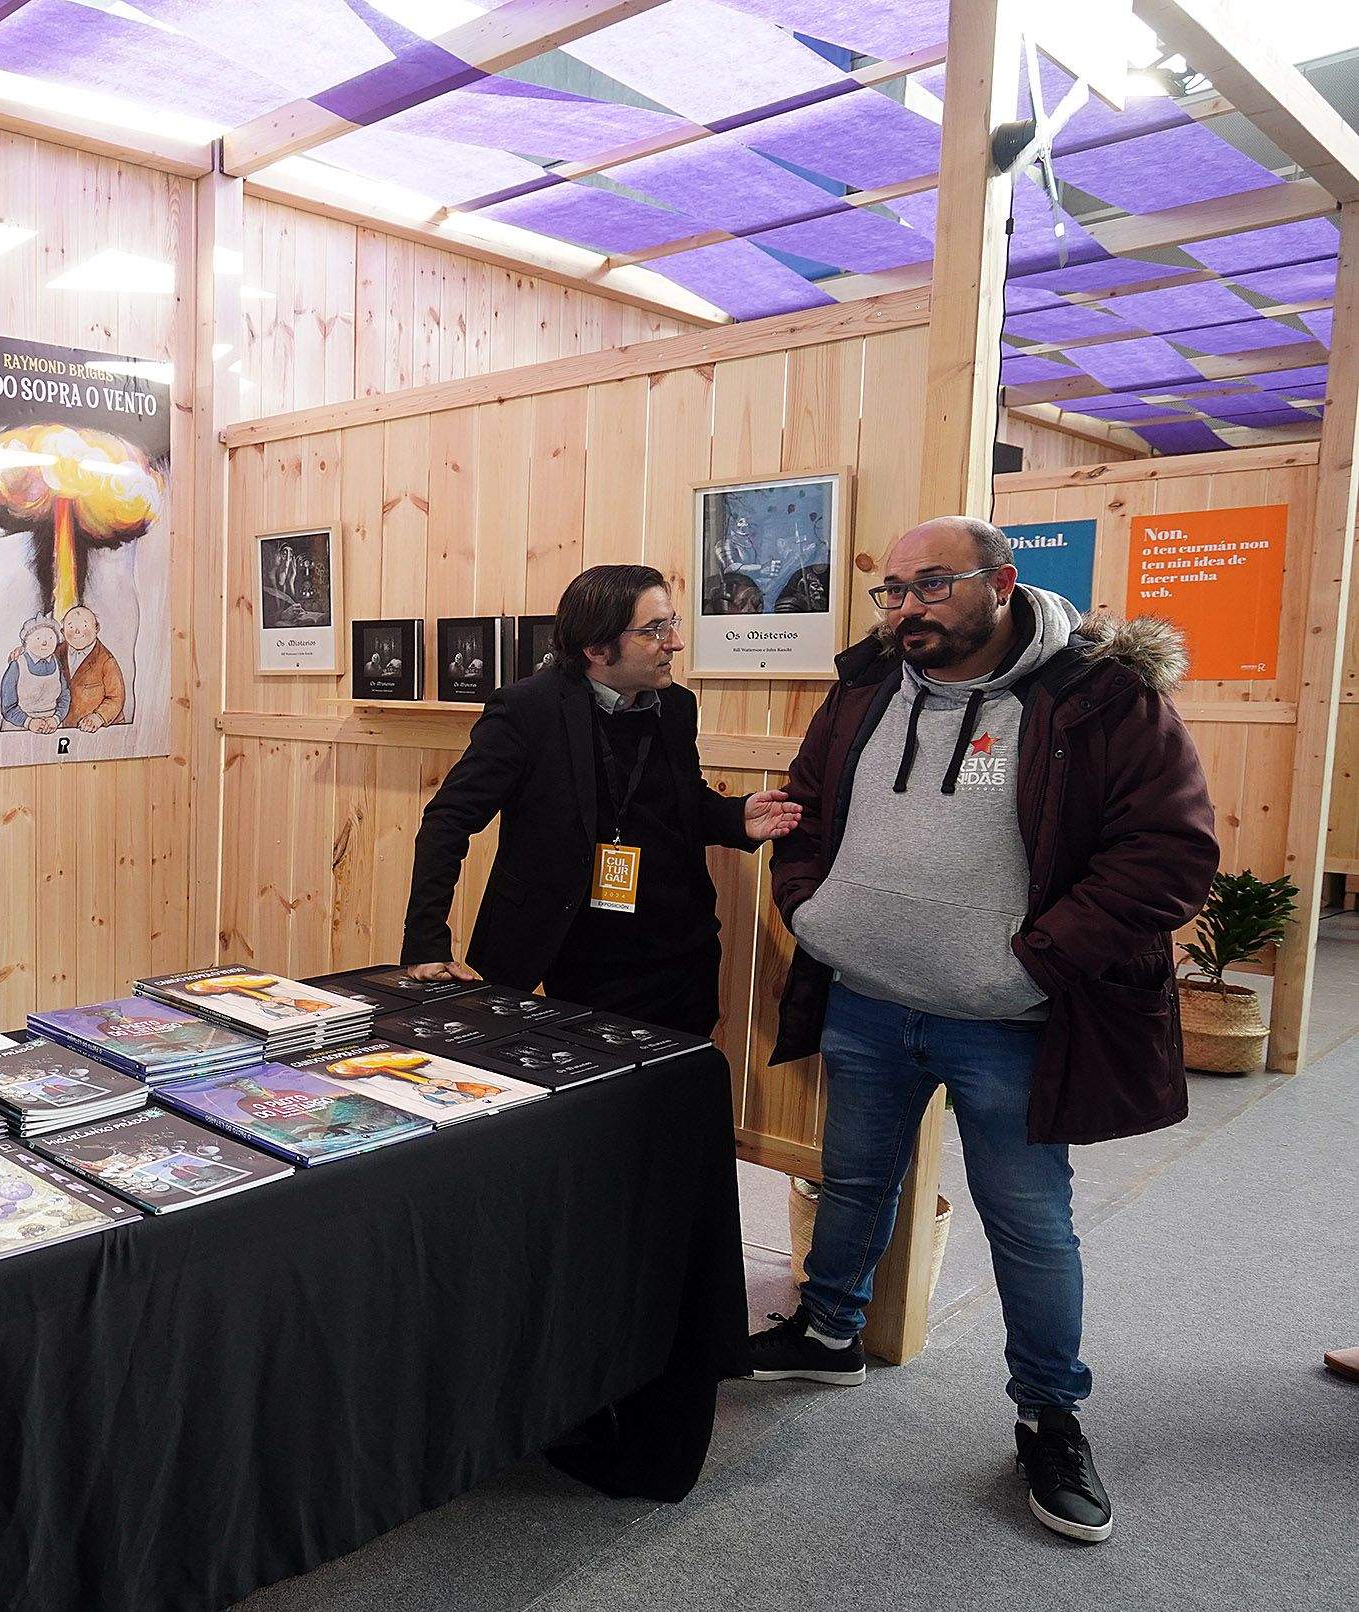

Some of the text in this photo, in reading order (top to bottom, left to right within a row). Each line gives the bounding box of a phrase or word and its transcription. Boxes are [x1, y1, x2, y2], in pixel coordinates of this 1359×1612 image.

[2, 352, 115, 382] RAYMOND BRIGGS
[20, 376, 83, 409] SOPRA
[85, 386, 100, 409] O
[102, 387, 158, 417] VENTO
[1144, 527, 1188, 542] Non,
[1142, 539, 1269, 556] o teu curmán non
[1142, 554, 1247, 570] ten nin idea de
[1141, 571, 1218, 584] facer unha
[1140, 586, 1173, 599] web.
[725, 630, 799, 641] Os Misterios
[606, 856, 629, 867] CUL
[606, 864, 629, 876] TUR
